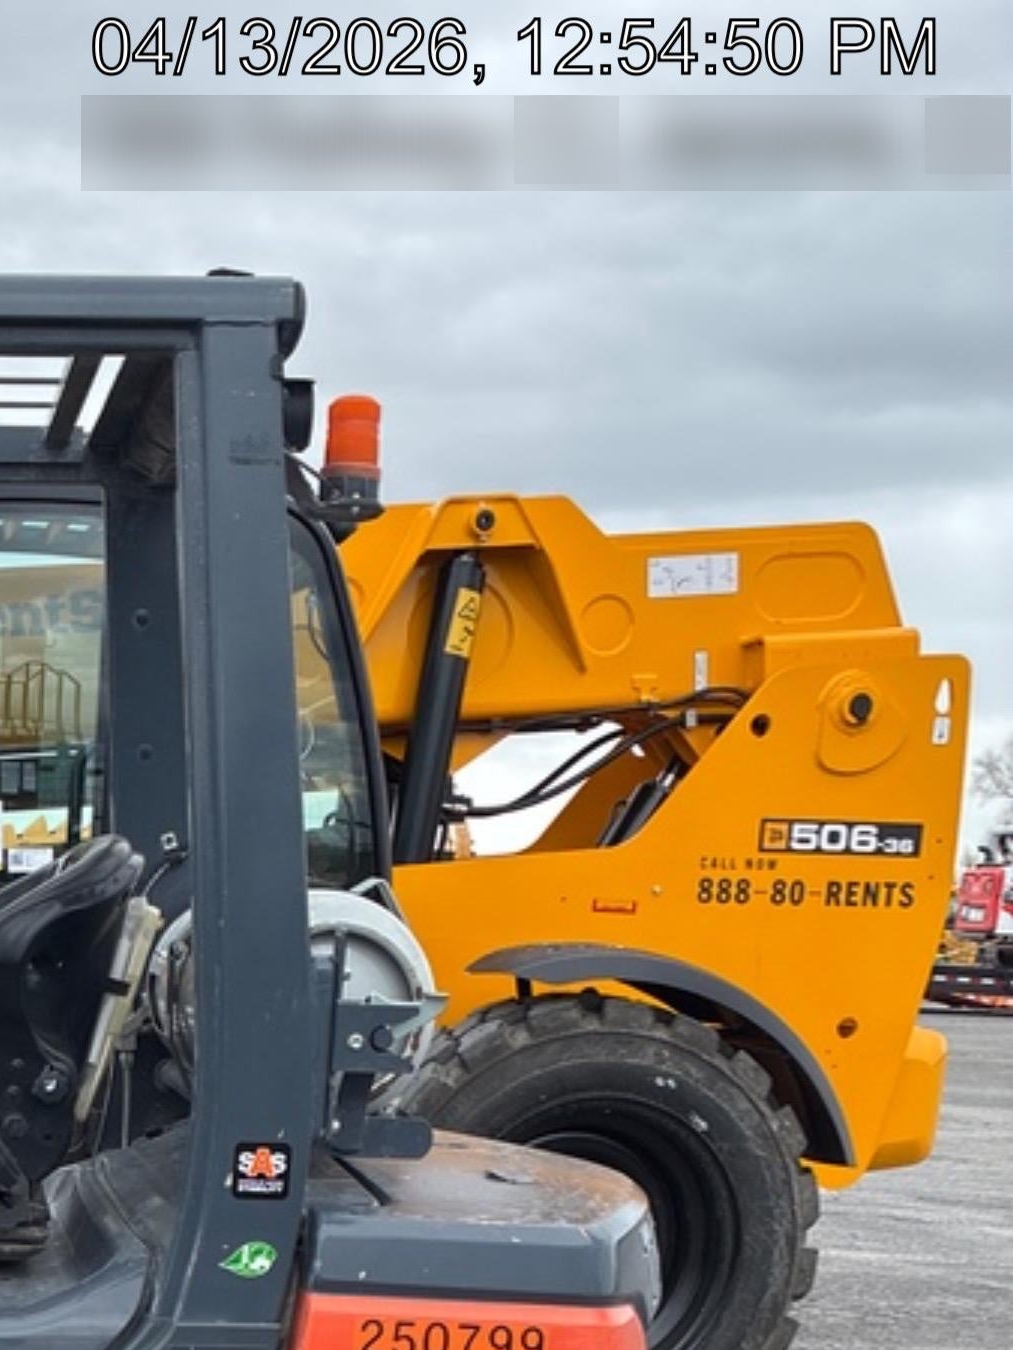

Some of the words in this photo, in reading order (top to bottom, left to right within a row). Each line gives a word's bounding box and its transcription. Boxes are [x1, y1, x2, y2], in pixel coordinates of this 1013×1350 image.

[700, 856, 737, 870] CALL
[745, 858, 778, 871] NOW
[697, 877, 916, 909] 888-80-RENTS
[238, 1148, 287, 1177] SAS
